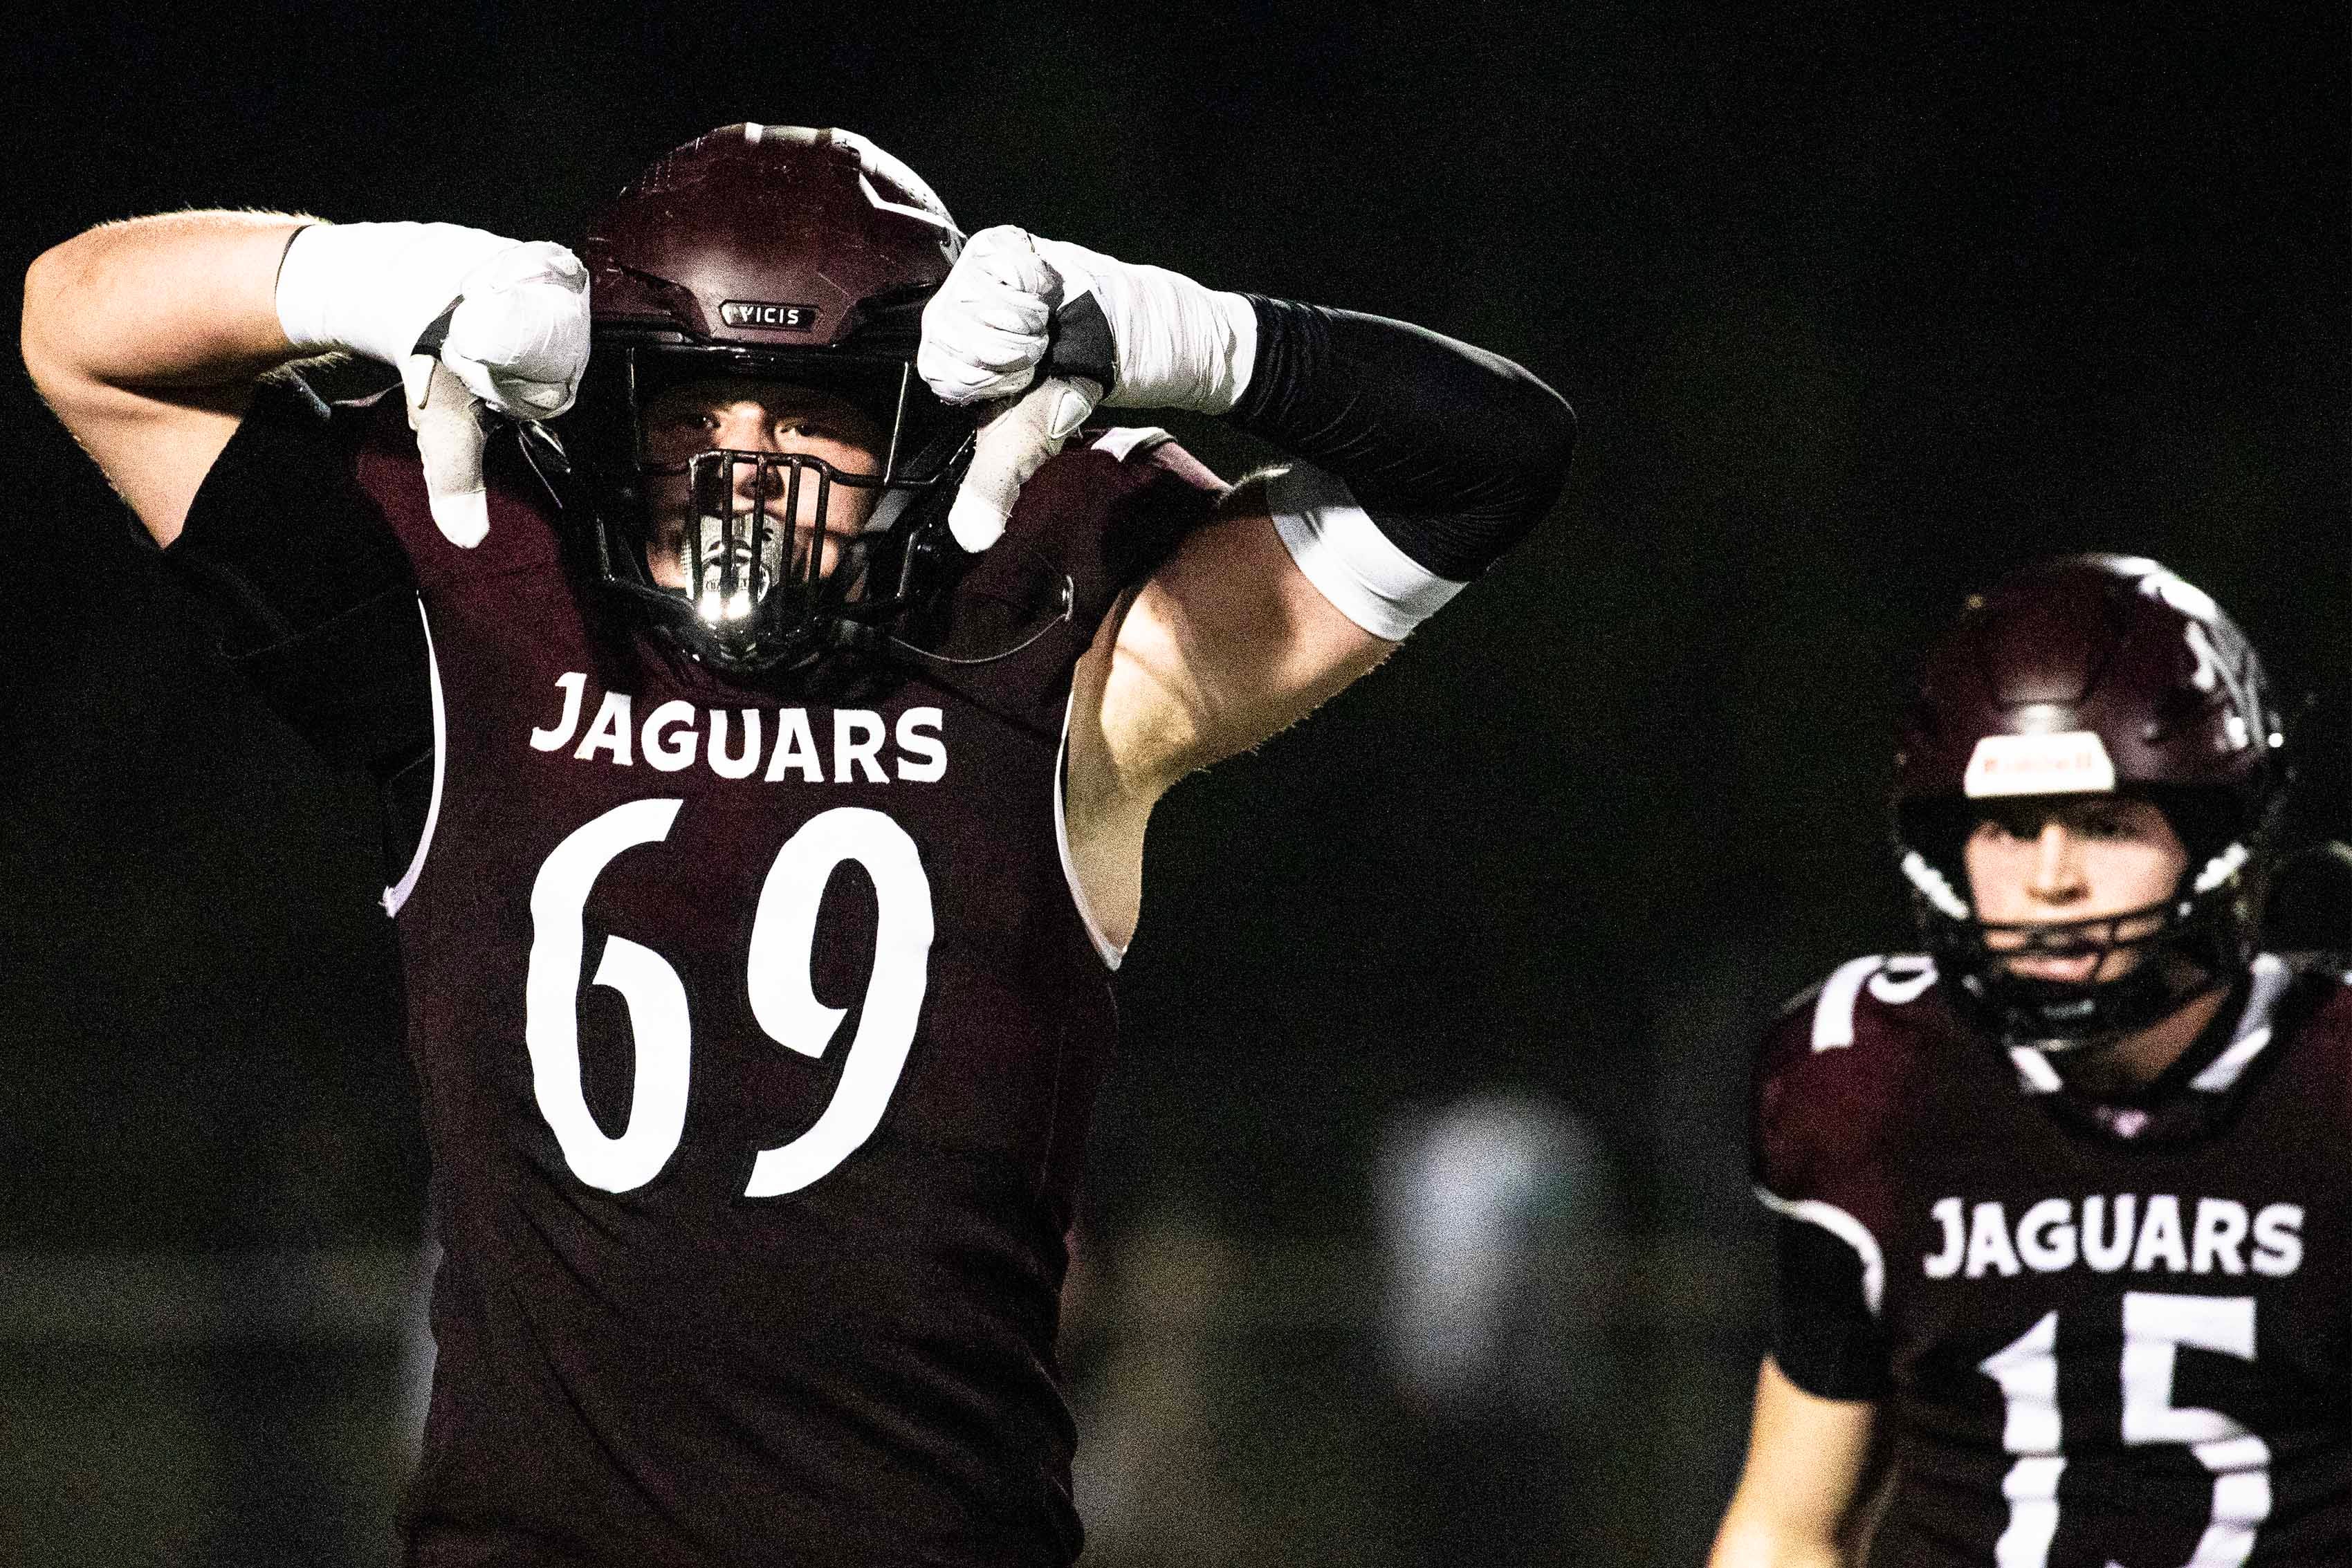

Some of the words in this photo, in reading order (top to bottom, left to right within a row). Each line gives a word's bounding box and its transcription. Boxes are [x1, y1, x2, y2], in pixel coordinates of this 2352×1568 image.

[738, 306, 800, 324] VICIS
[529, 671, 948, 784] JAGUARS
[525, 797, 935, 1198] 69
[1923, 1193, 2305, 1278] JAGUARS
[1977, 1291, 2272, 1568] 15
